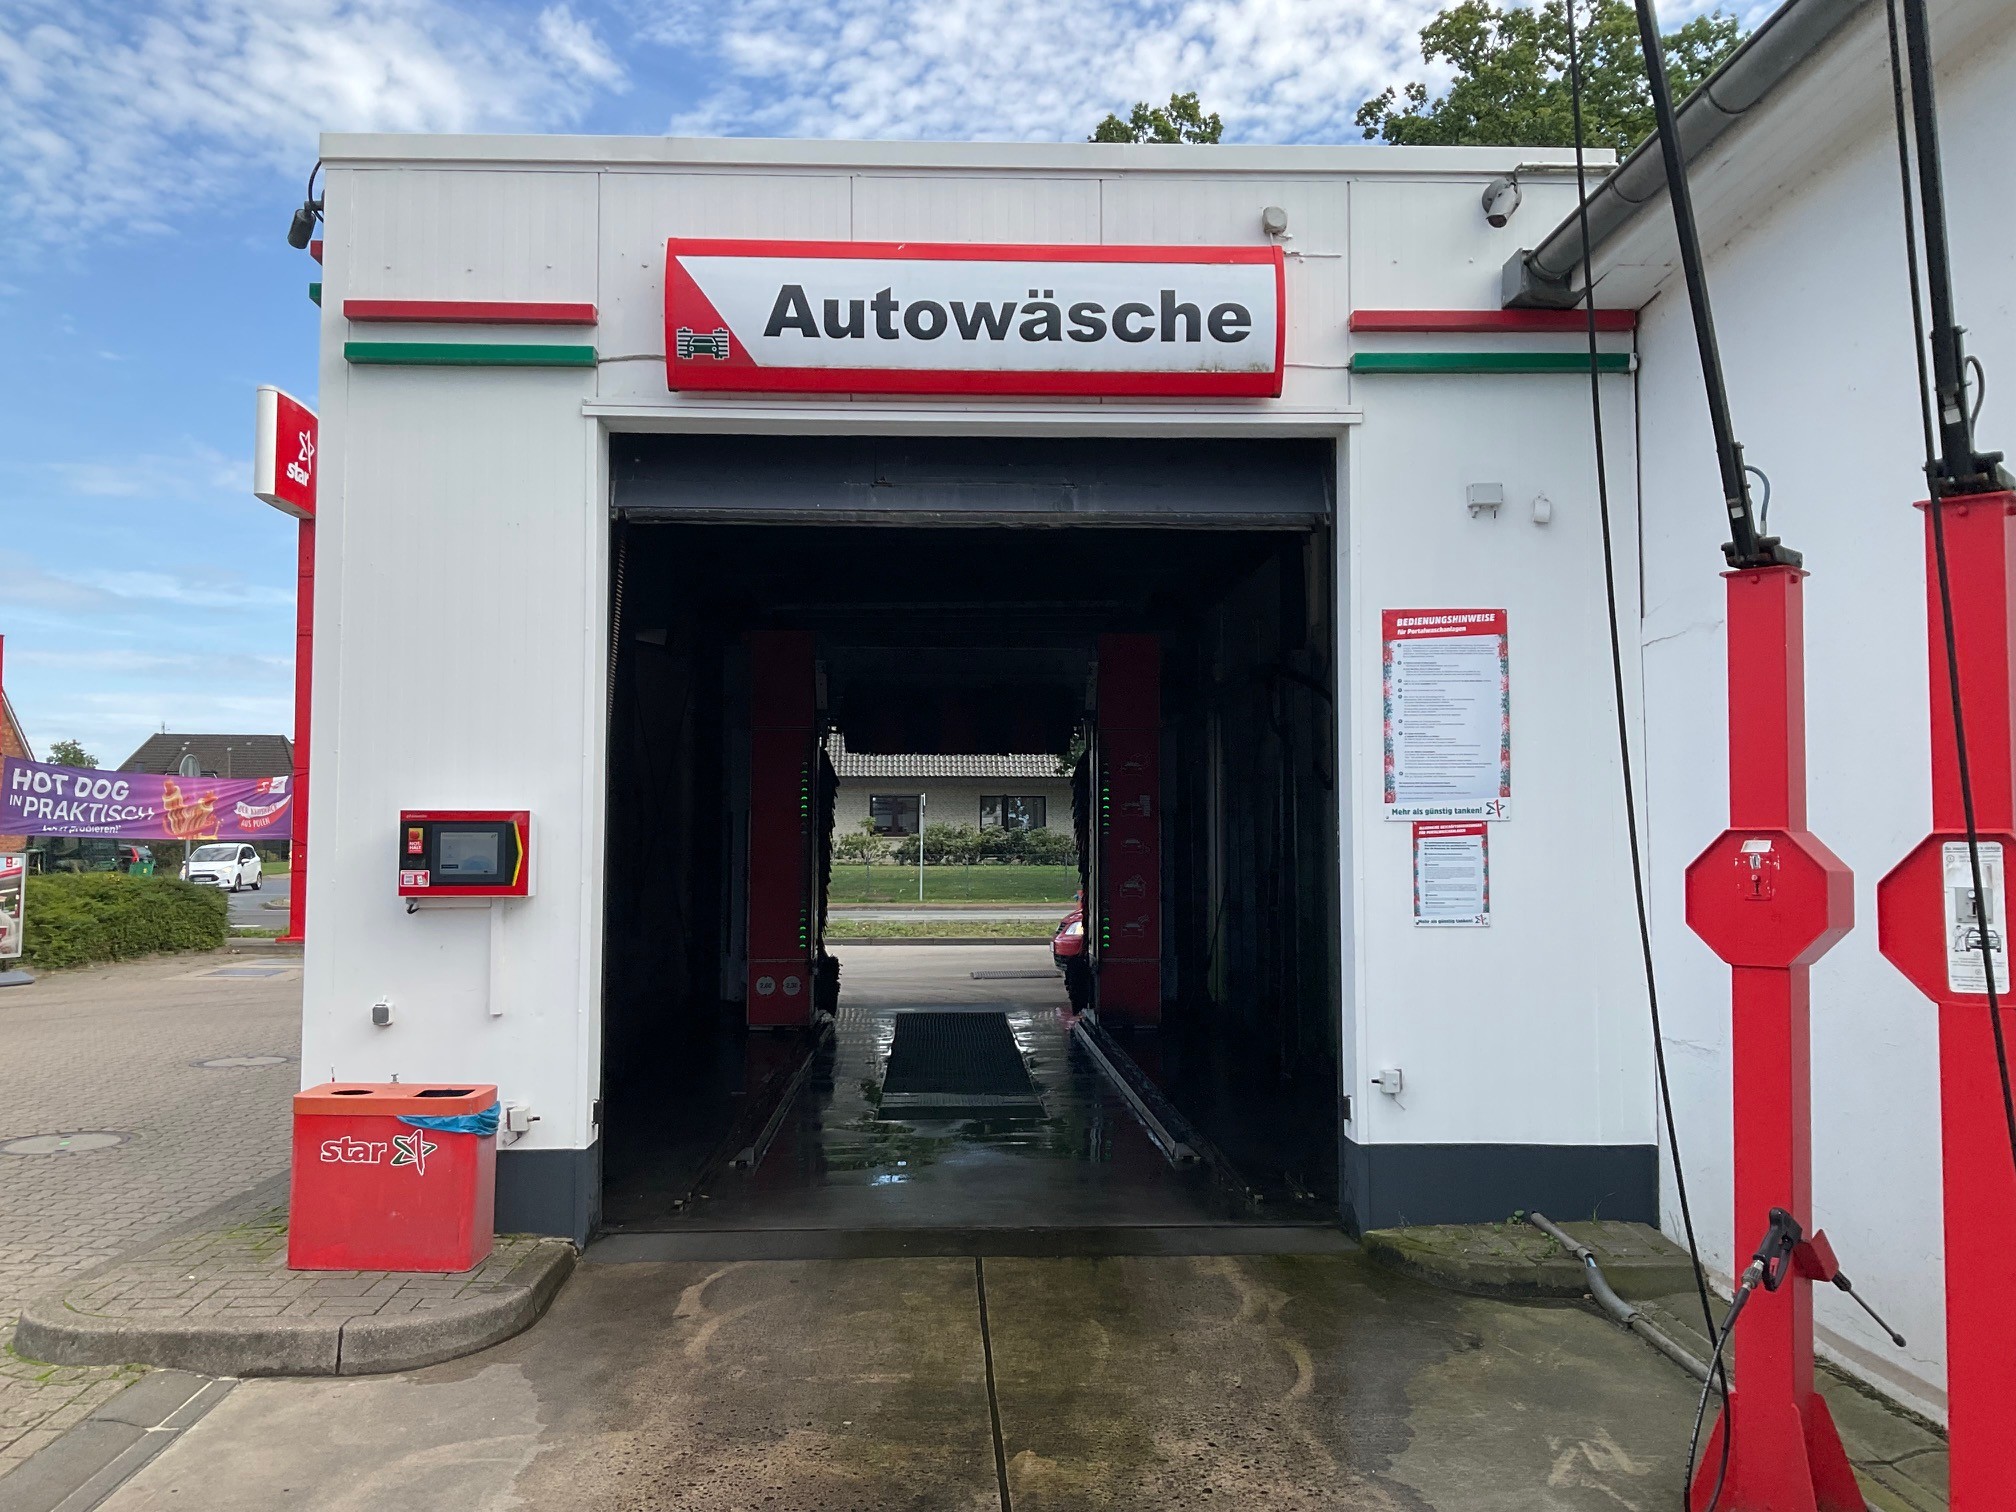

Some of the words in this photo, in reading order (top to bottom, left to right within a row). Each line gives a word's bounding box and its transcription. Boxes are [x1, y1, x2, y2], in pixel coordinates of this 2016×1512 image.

[763, 284, 1252, 344] Autowäsche
[286, 461, 310, 487] star
[1396, 613, 1496, 627] BEDIENUNGSHINWEISE
[1397, 628, 1406, 636] für
[1407, 626, 1467, 636] Portalwaschanlagen
[12, 768, 69, 796] HOT
[74, 776, 130, 801] DOG
[9, 794, 23, 807] IN
[1391, 808, 1411, 816] Mehr
[1412, 807, 1423, 816] als
[1424, 807, 1453, 817] günstig
[1454, 806, 1483, 815] tanken!
[240, 818, 252, 828] AUS
[252, 816, 271, 828] POLEN
[321, 1136, 388, 1164] star
